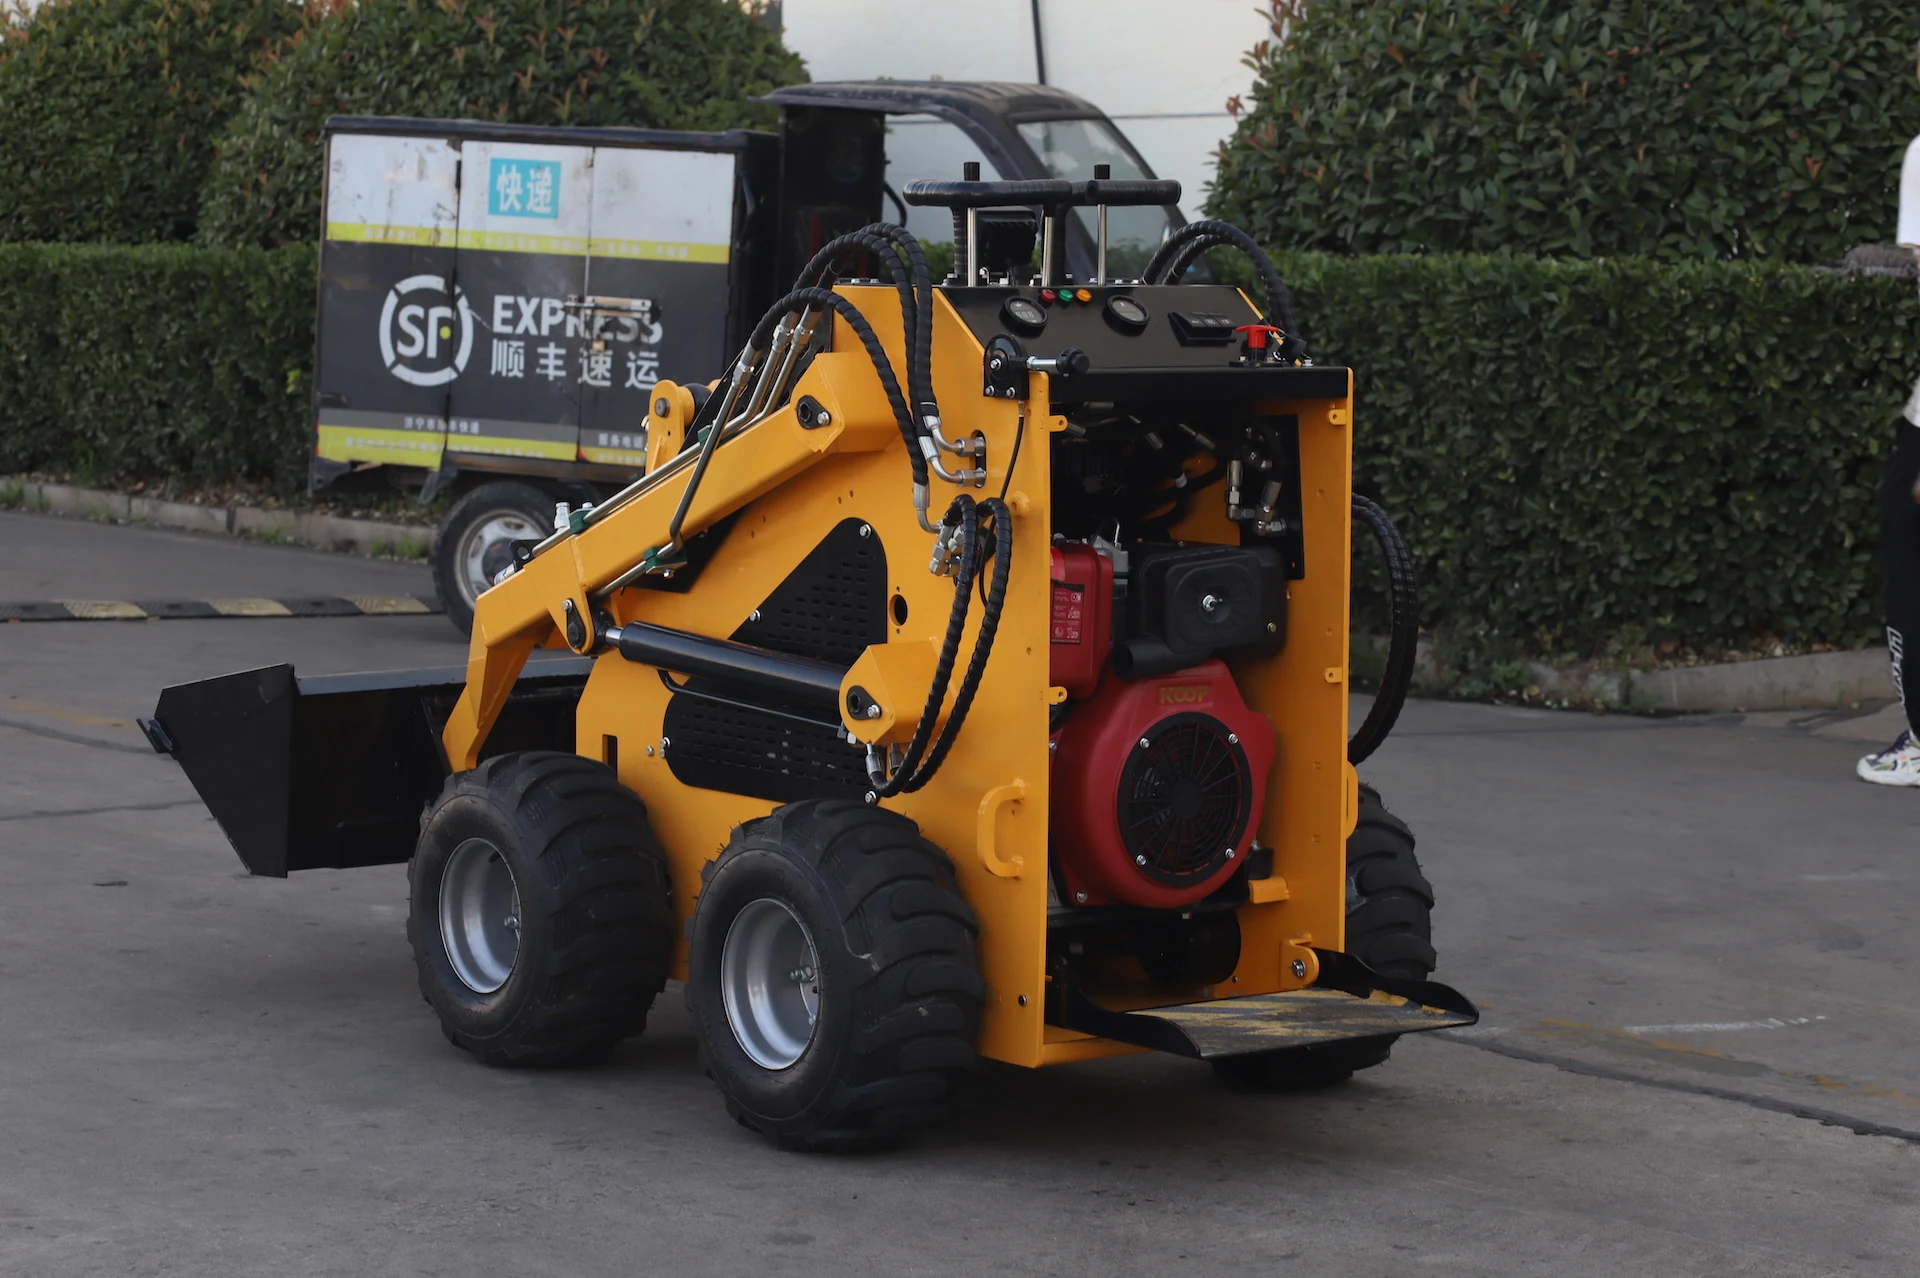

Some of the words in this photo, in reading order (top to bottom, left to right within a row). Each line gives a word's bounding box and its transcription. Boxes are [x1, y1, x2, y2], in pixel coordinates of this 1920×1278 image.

[496, 163, 552, 214] 快递
[490, 338, 659, 390] 顺丰速运
[1160, 685, 1209, 704] KOOP
